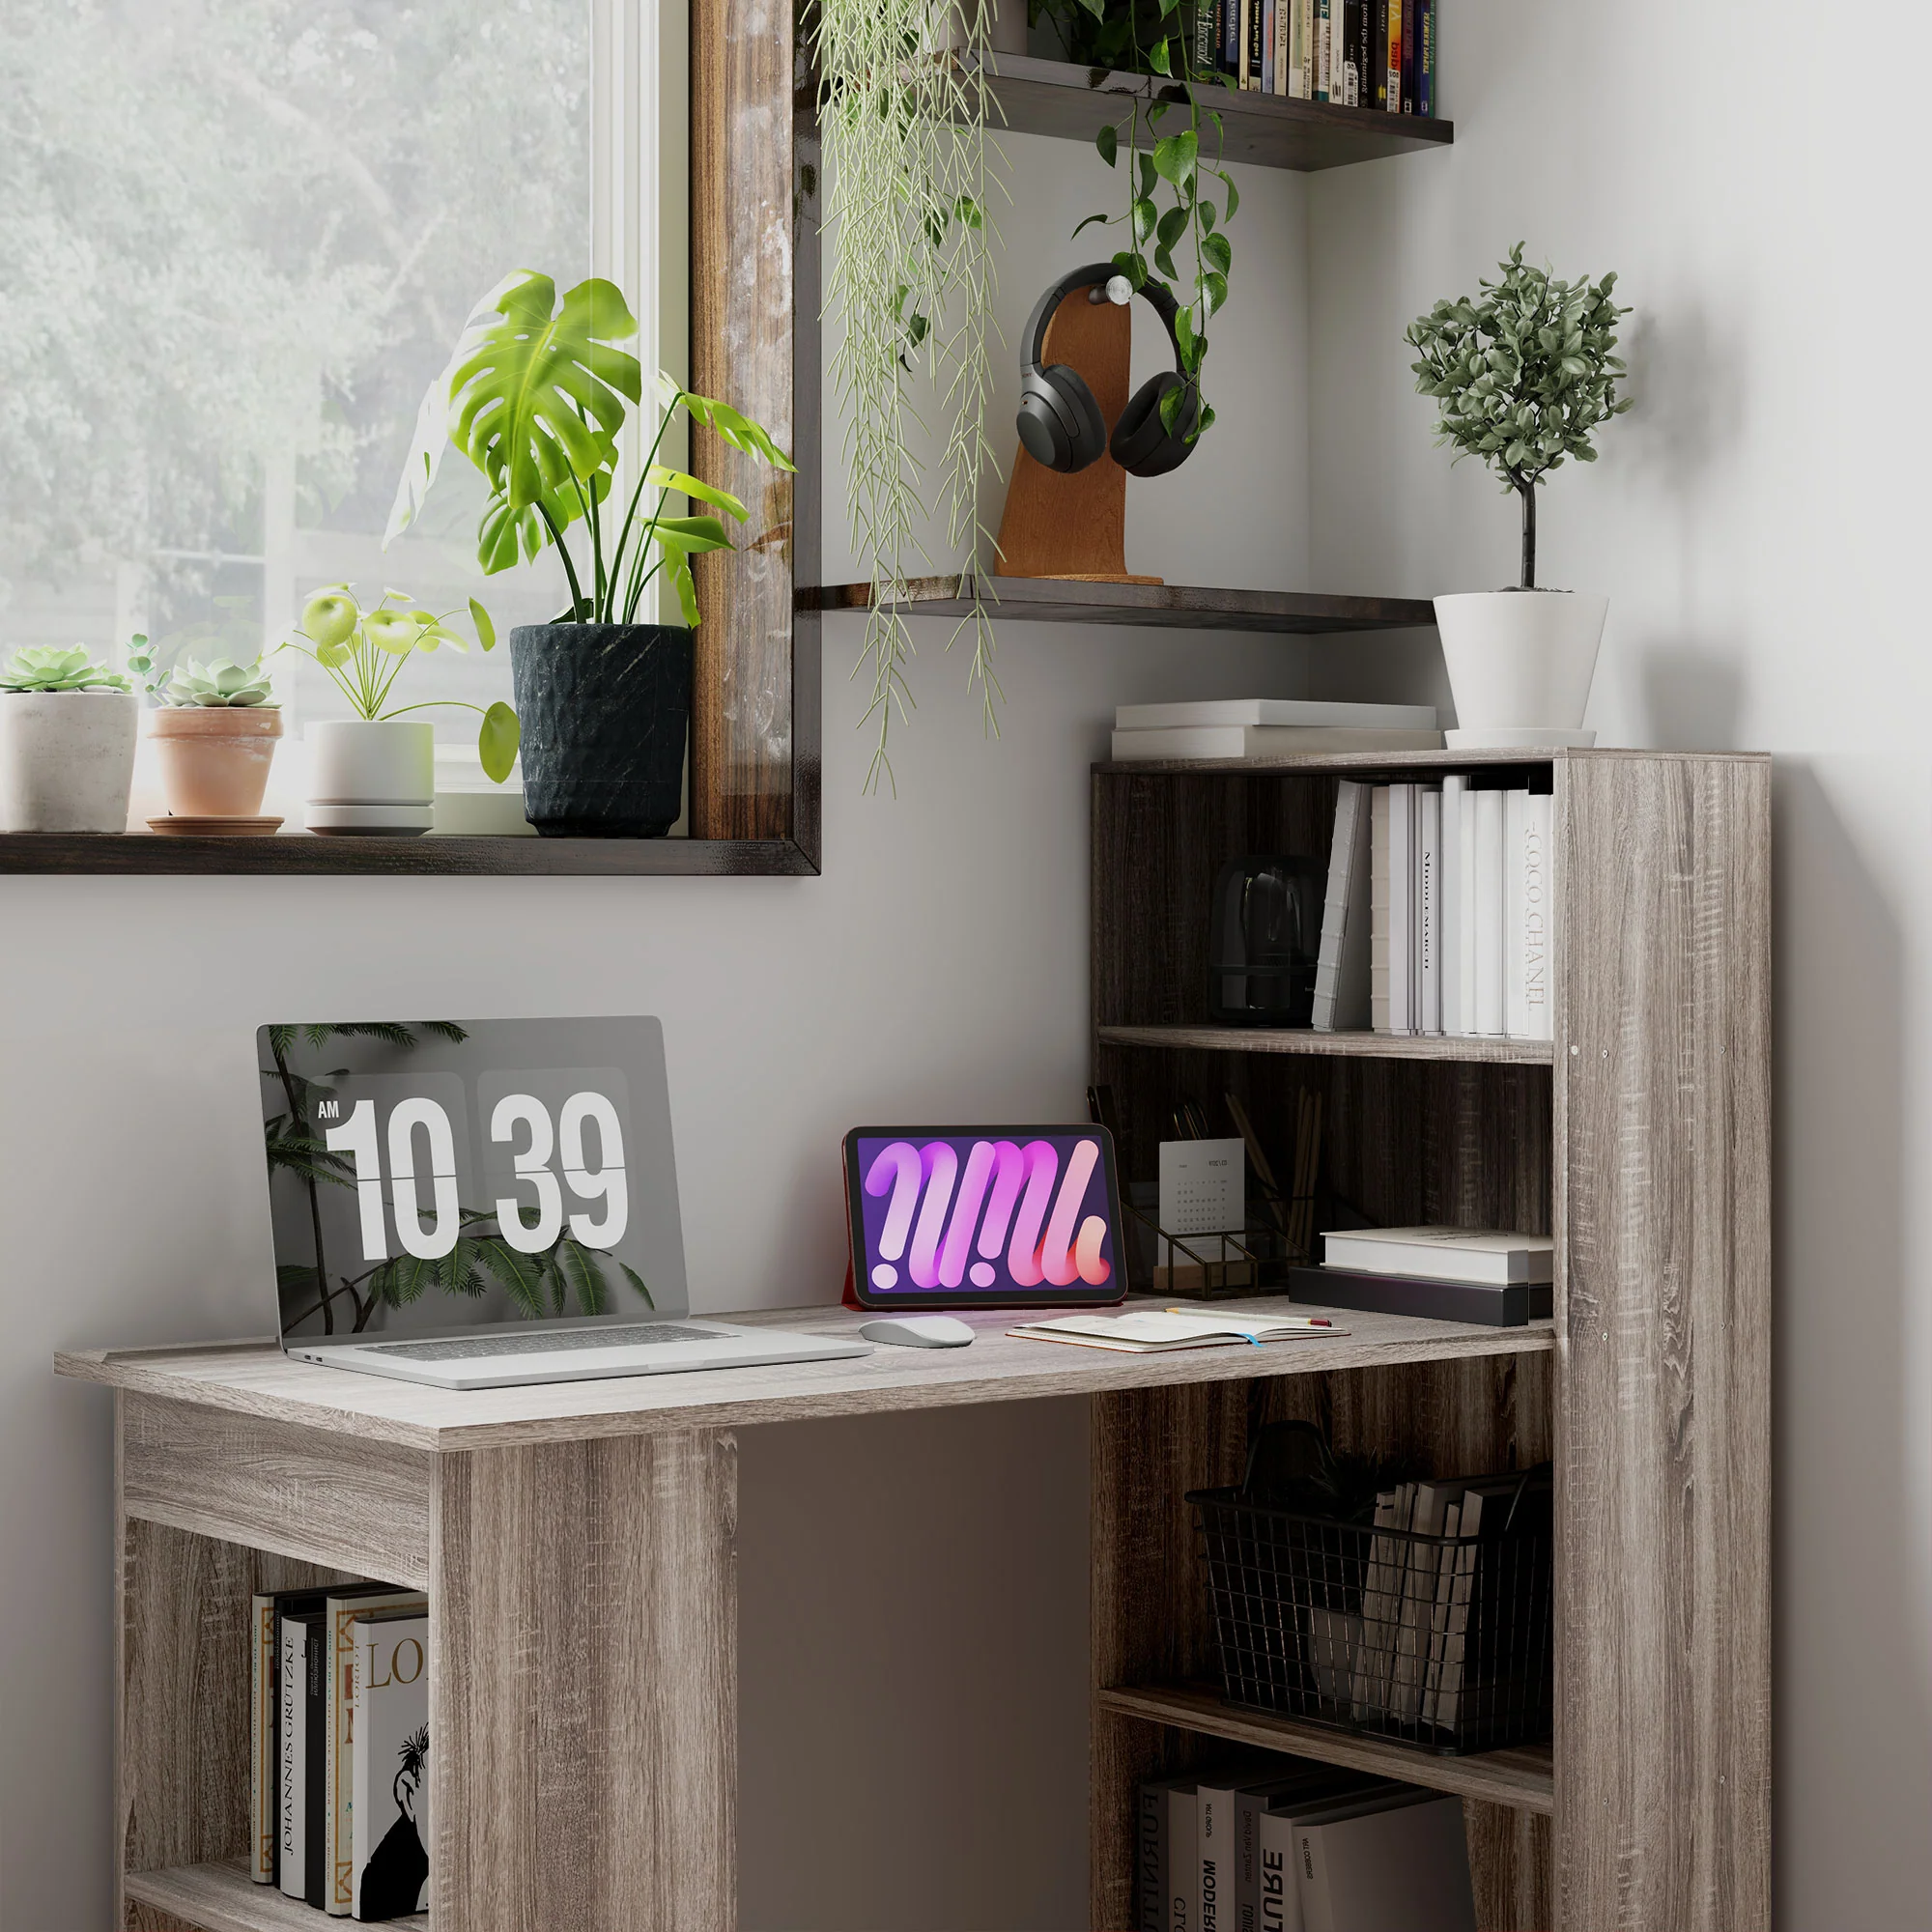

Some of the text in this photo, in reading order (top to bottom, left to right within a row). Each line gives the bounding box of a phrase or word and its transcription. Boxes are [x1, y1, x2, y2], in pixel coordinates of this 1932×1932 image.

[1526, 833, 1545, 1011] COCO CHANEL
[317, 1100, 340, 1120] AM
[325, 1092, 629, 1262] 10 39
[281, 1636, 294, 1856] JOHANNES GRÜTZKE
[365, 1637, 429, 1689] LO
